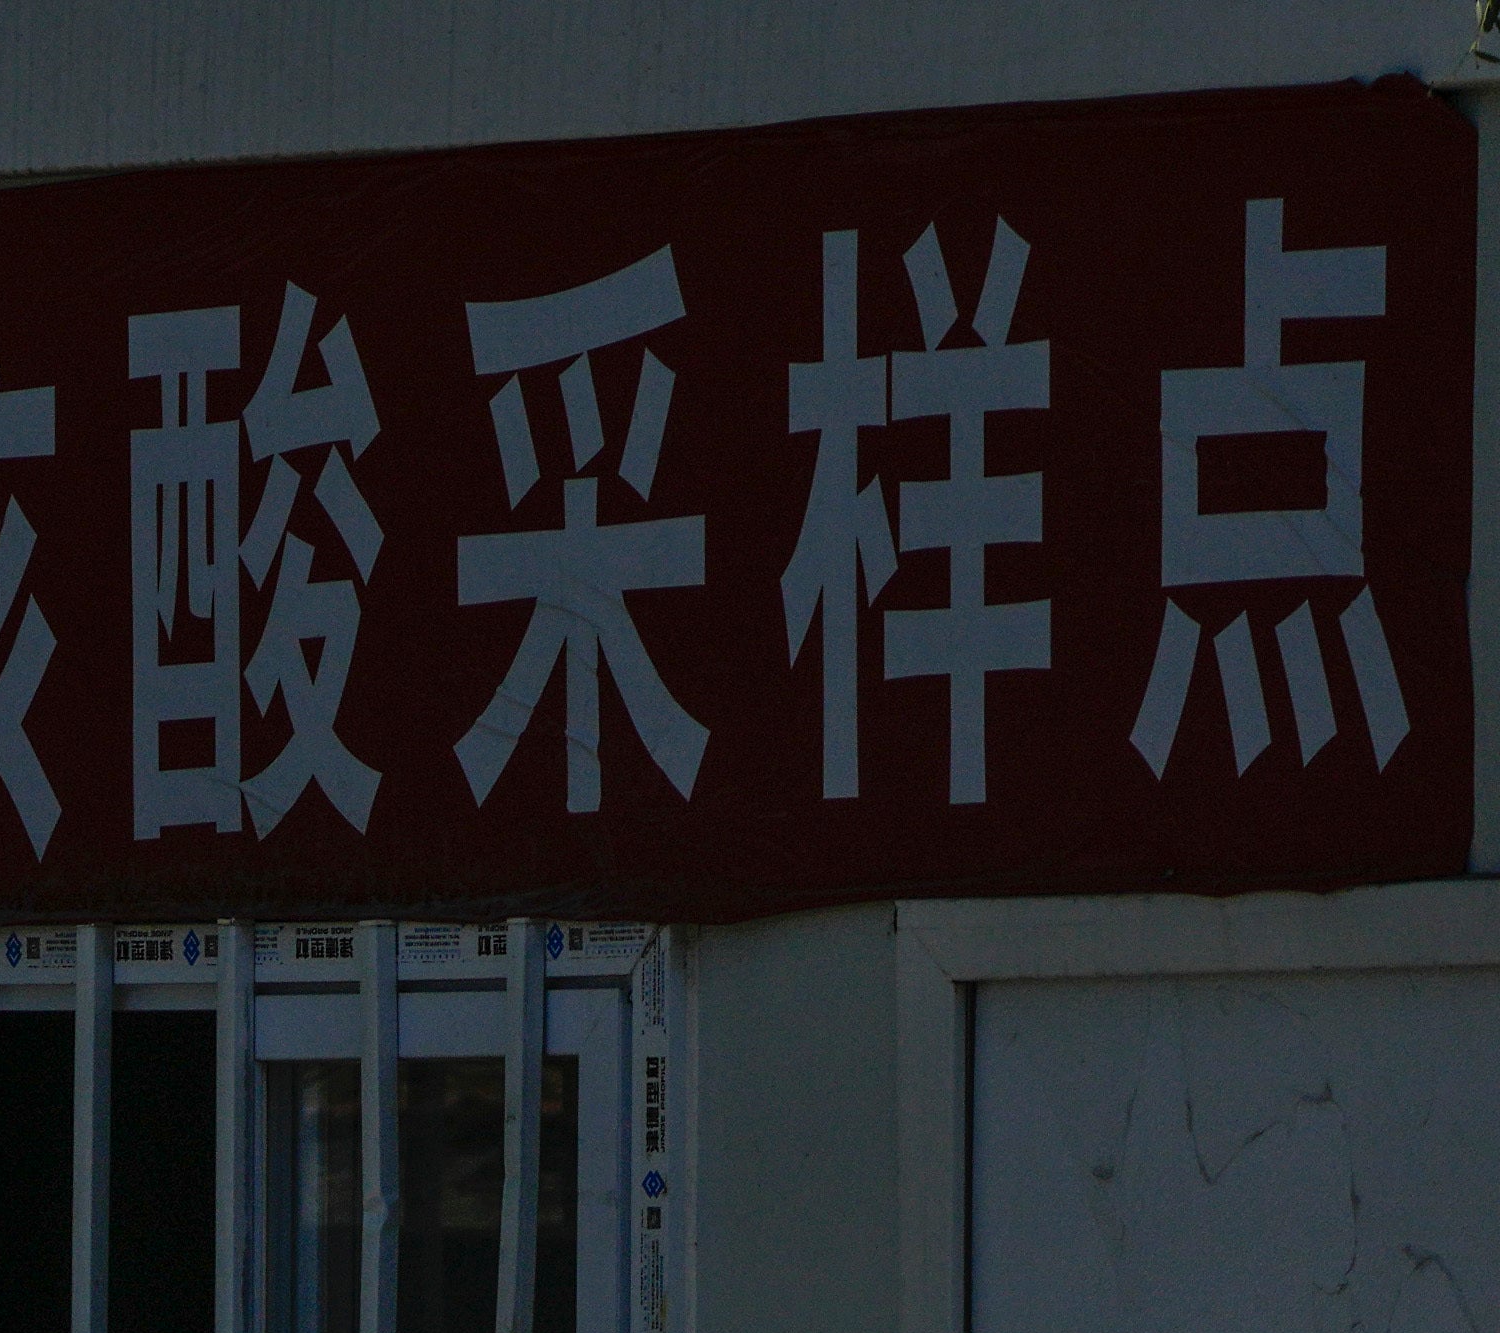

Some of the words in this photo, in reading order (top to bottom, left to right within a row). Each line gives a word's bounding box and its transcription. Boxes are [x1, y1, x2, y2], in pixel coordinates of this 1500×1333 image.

[116, 940, 174, 961] 津德型材
[295, 937, 354, 959] 津德型材
[645, 1056, 660, 1153] 津德型材
